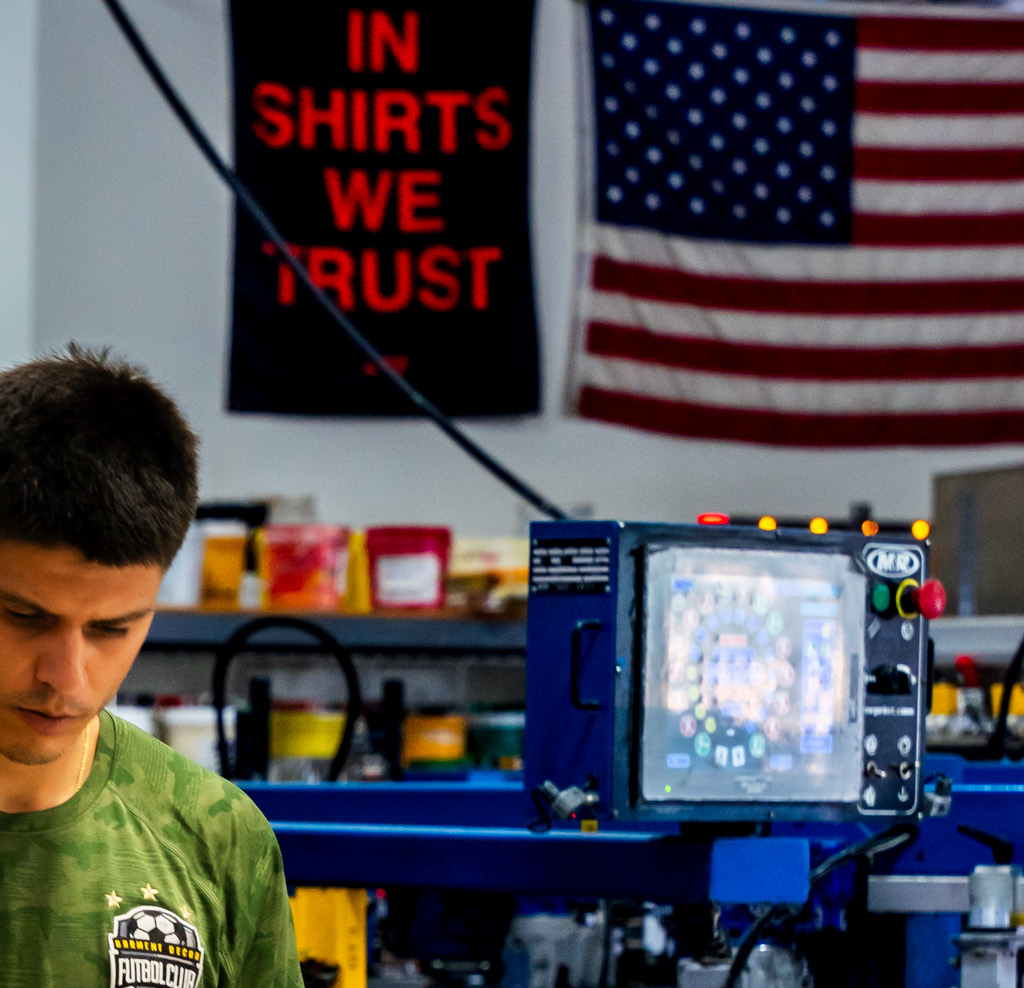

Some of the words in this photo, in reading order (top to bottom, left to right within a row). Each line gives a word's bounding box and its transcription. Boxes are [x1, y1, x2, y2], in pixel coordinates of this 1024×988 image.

[346, 8, 420, 74] IN
[251, 80, 513, 155] SHIRTS
[322, 167, 446, 233] WE
[261, 242, 503, 312] TRUST
[118, 958, 165, 986] FUTBOL
